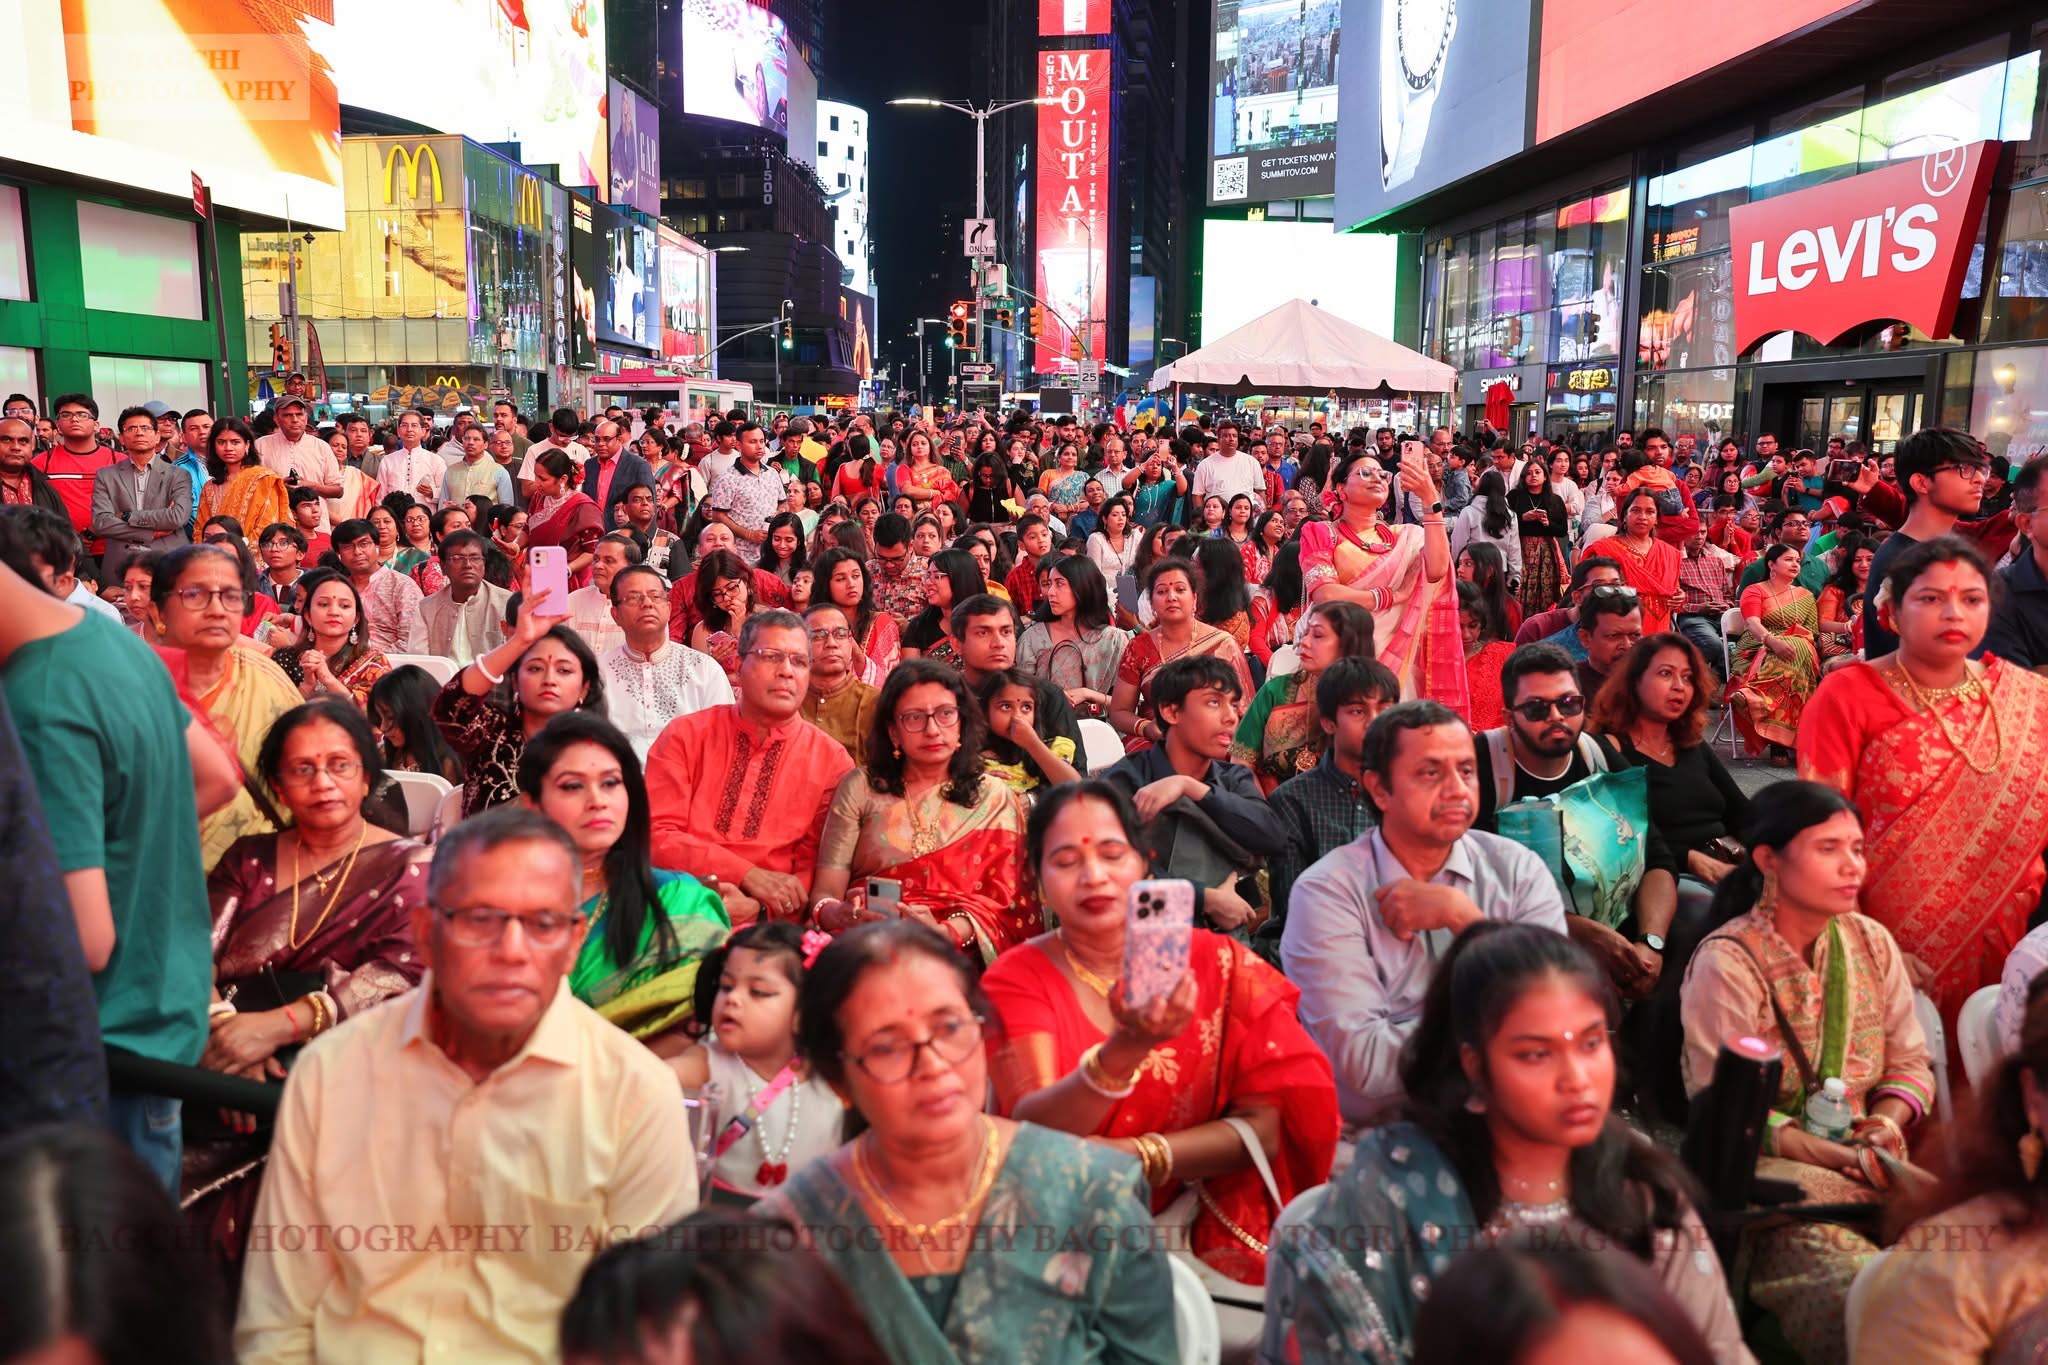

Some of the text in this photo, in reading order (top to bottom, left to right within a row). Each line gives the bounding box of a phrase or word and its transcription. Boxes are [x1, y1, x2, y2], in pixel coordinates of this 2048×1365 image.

[640, 131, 657, 178] GAP
[1058, 53, 1090, 245] MOUTAI
[1261, 158, 1277, 168] GET
[1278, 155, 1309, 166] TICKETS
[1310, 152, 1329, 162] NOW
[1261, 166, 1318, 179] SUMMITOV.COM
[763, 158, 773, 205] 1500
[969, 245, 988, 254] ONLY
[1000, 301, 1008, 309] 45
[1082, 372, 1097, 382] 25
